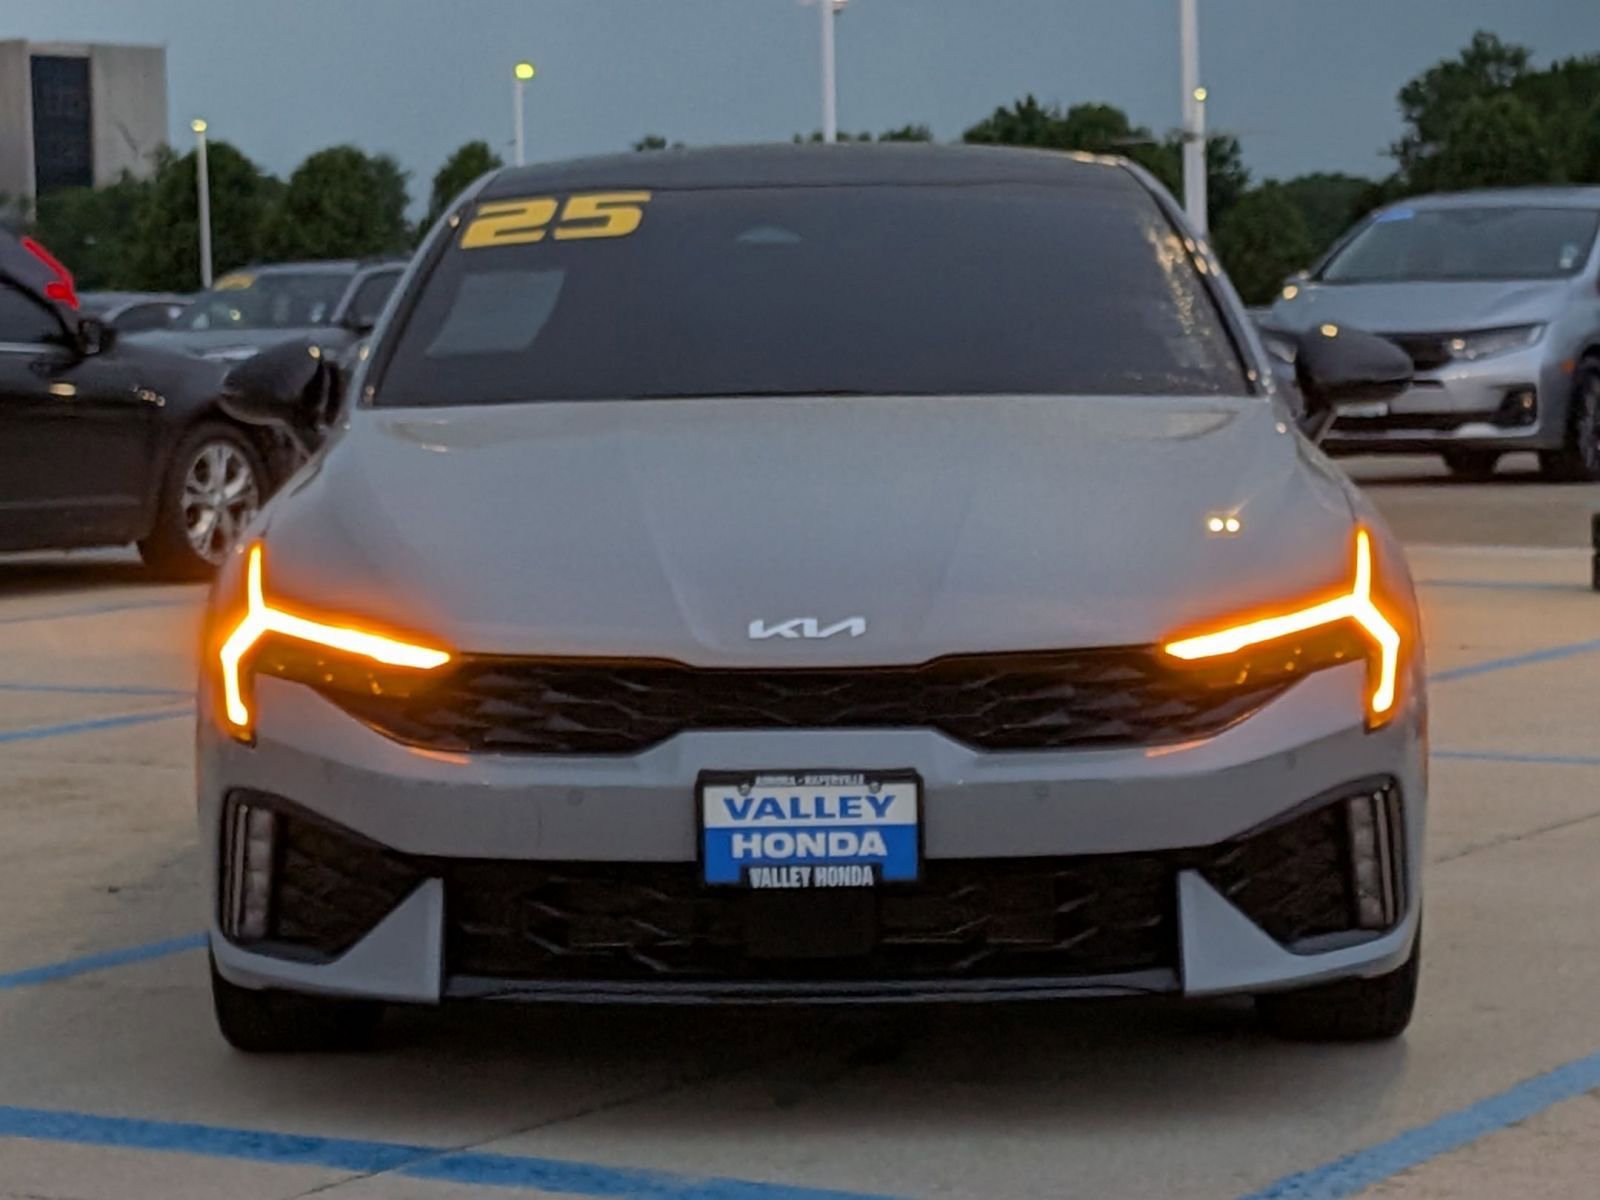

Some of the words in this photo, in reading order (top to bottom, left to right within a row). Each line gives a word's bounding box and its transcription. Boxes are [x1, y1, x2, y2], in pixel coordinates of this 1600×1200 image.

[460, 191, 651, 249] 25
[723, 795, 896, 820] VALLEY
[732, 831, 888, 859] HONDA
[749, 867, 811, 888] VALLEY
[814, 865, 874, 887] HONDA
